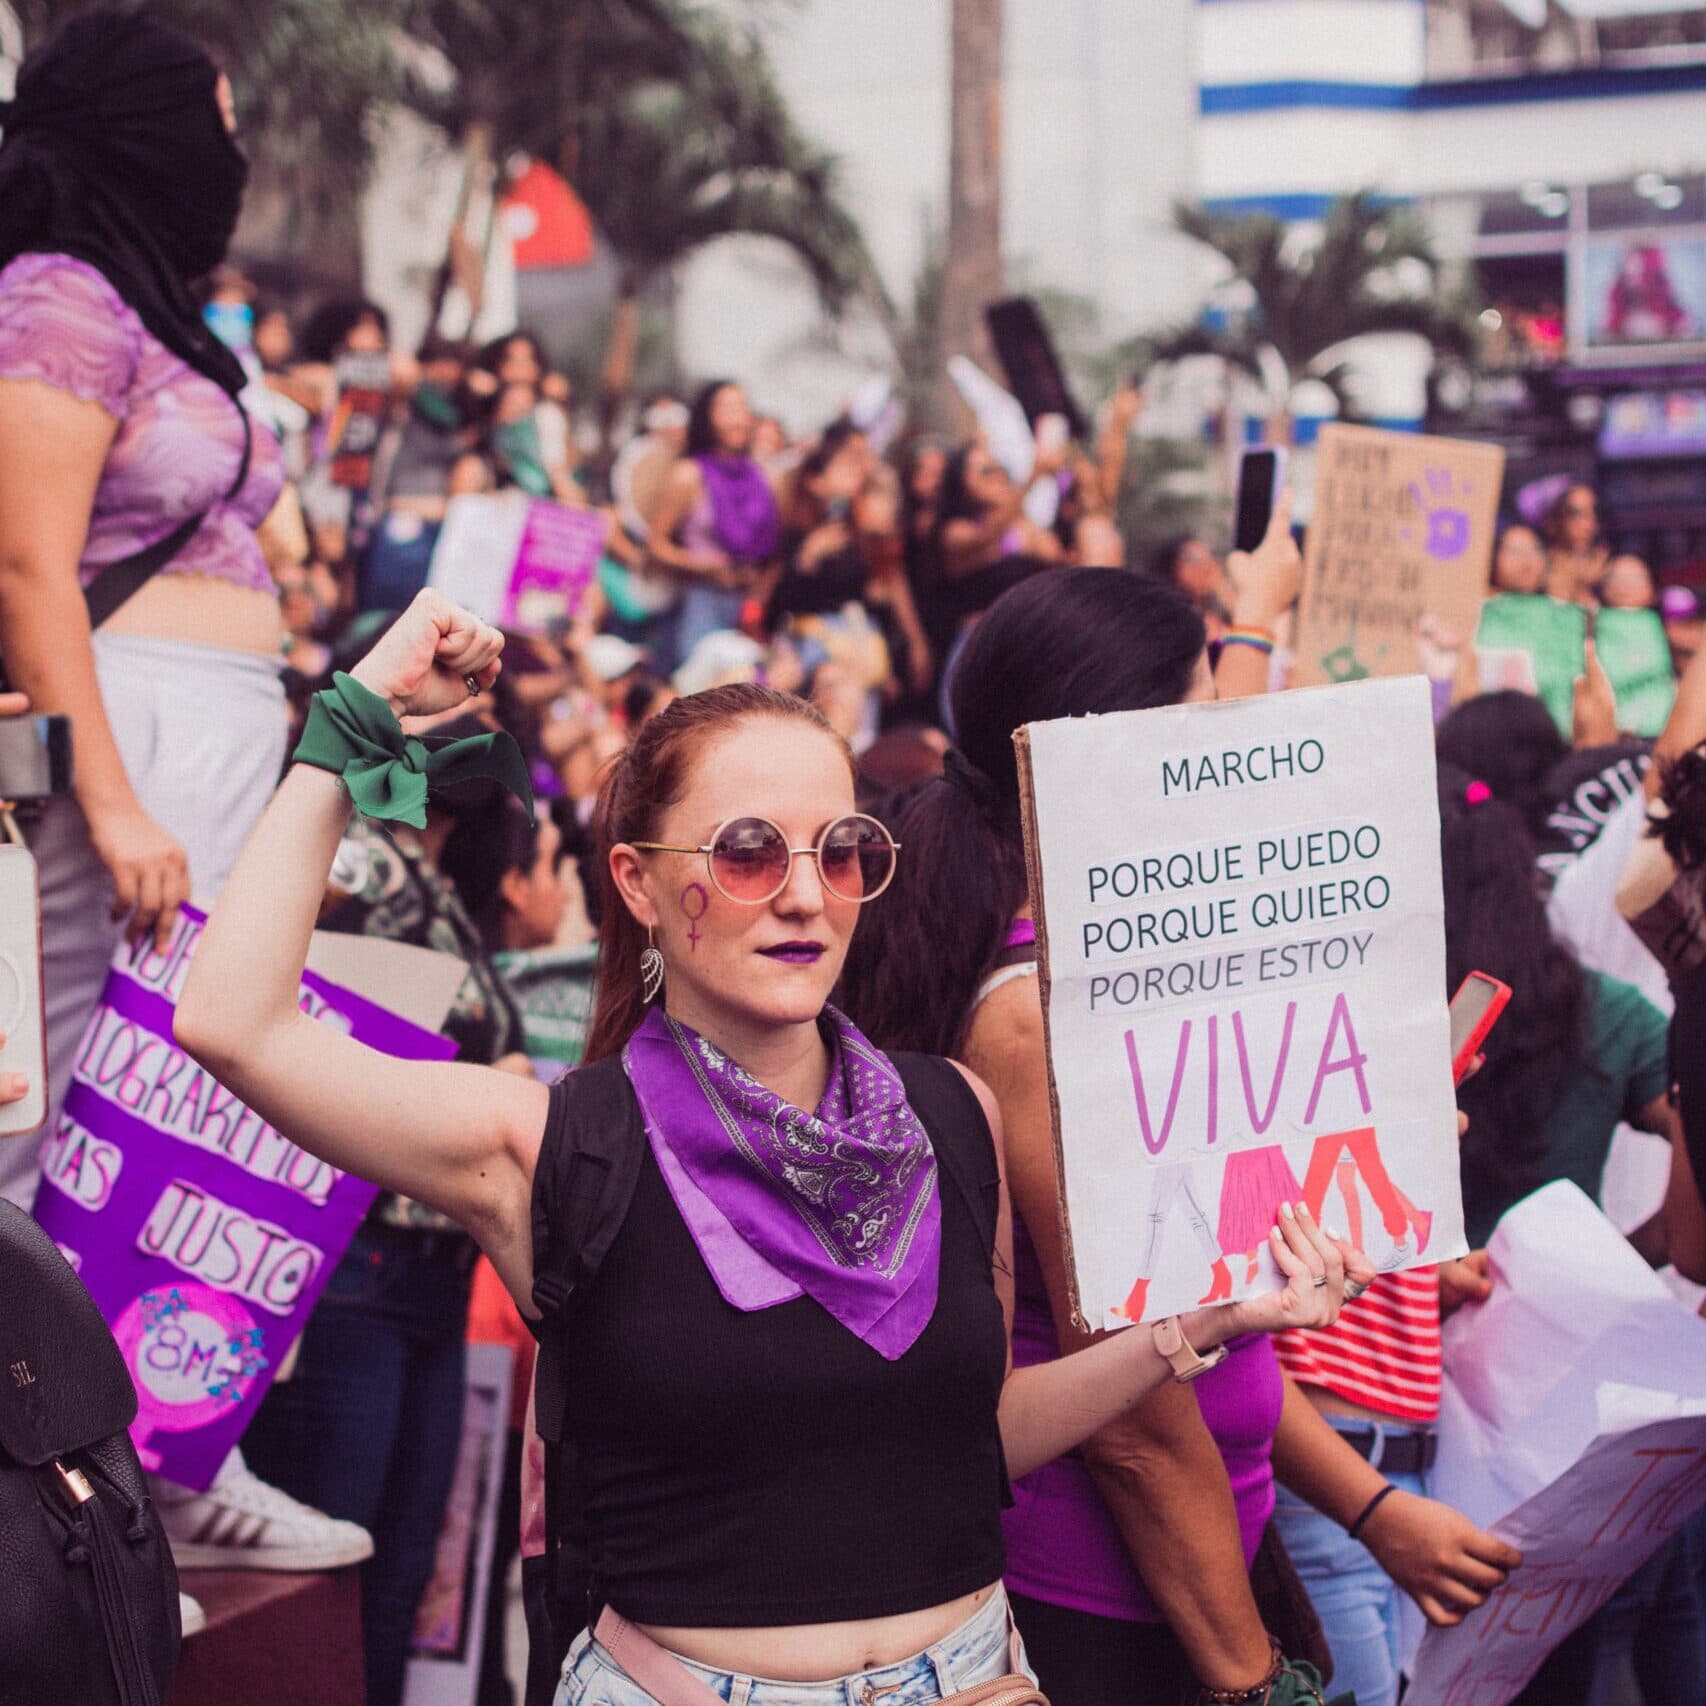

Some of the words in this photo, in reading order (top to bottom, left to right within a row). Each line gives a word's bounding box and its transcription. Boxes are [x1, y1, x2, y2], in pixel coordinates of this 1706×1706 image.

[1162, 739, 1325, 797] MARCHO
[1087, 844, 1244, 904] PORQUE
[1258, 824, 1381, 876] PUEDO
[1082, 898, 1239, 959] PORQUE
[1251, 874, 1391, 930] QUIERO
[1089, 952, 1246, 1011] PORQUE
[1259, 932, 1374, 982] ESTOY
[1123, 992, 1373, 1156] VIVA
[144, 1182, 316, 1308] JUSTO
[145, 1324, 217, 1383] 8M
